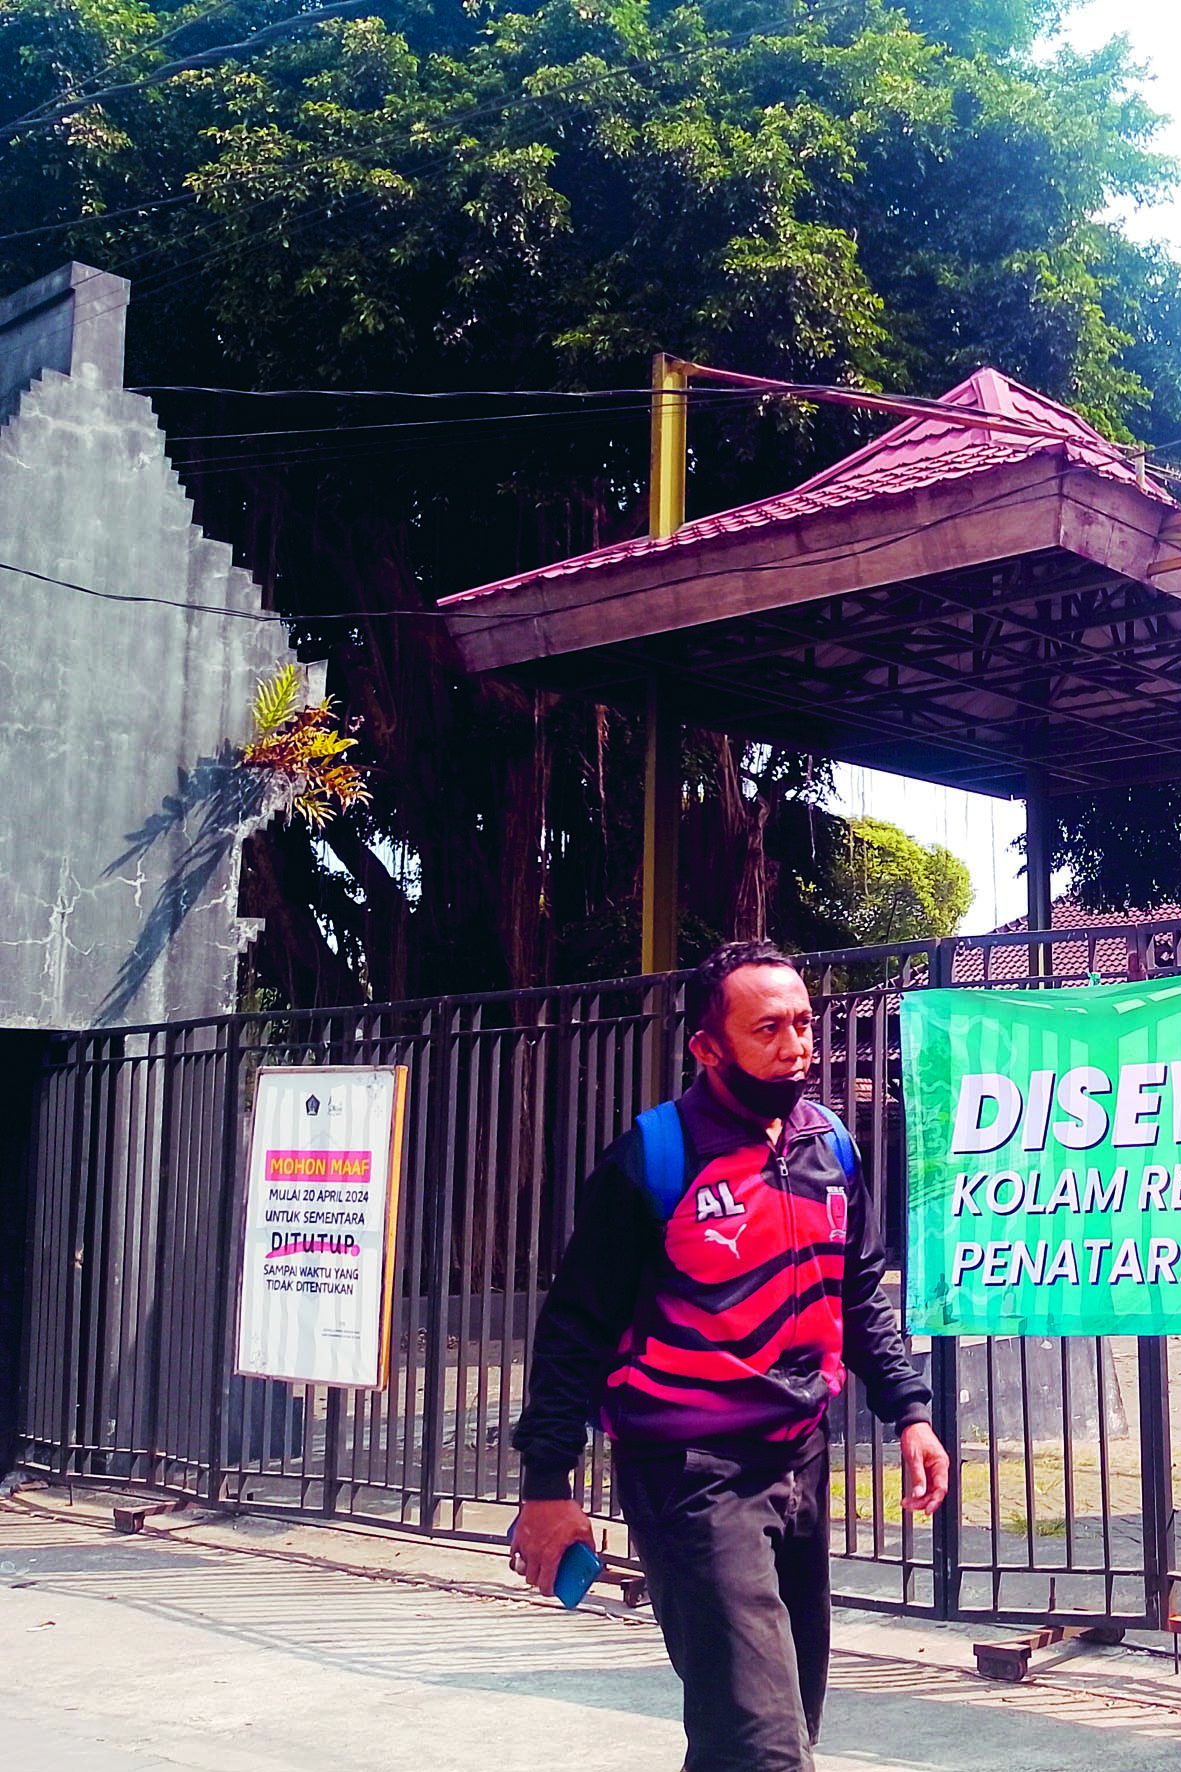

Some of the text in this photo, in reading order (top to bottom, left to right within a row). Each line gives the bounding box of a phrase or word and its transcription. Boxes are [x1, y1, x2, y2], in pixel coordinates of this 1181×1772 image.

[270, 1158, 370, 1176] MOHON MAAF
[269, 1189, 369, 1203] MULAI 20 APRIL 2024
[696, 1180, 745, 1222] AL
[951, 1168, 1127, 1217] KOLAM
[265, 1210, 365, 1225] UNTUK SEMENTARA
[271, 1232, 355, 1255] DITUTUP
[264, 1264, 359, 1280] SAMPAI WAKTU YANG
[266, 1279, 353, 1294] TIDAK DITENTUKAN
